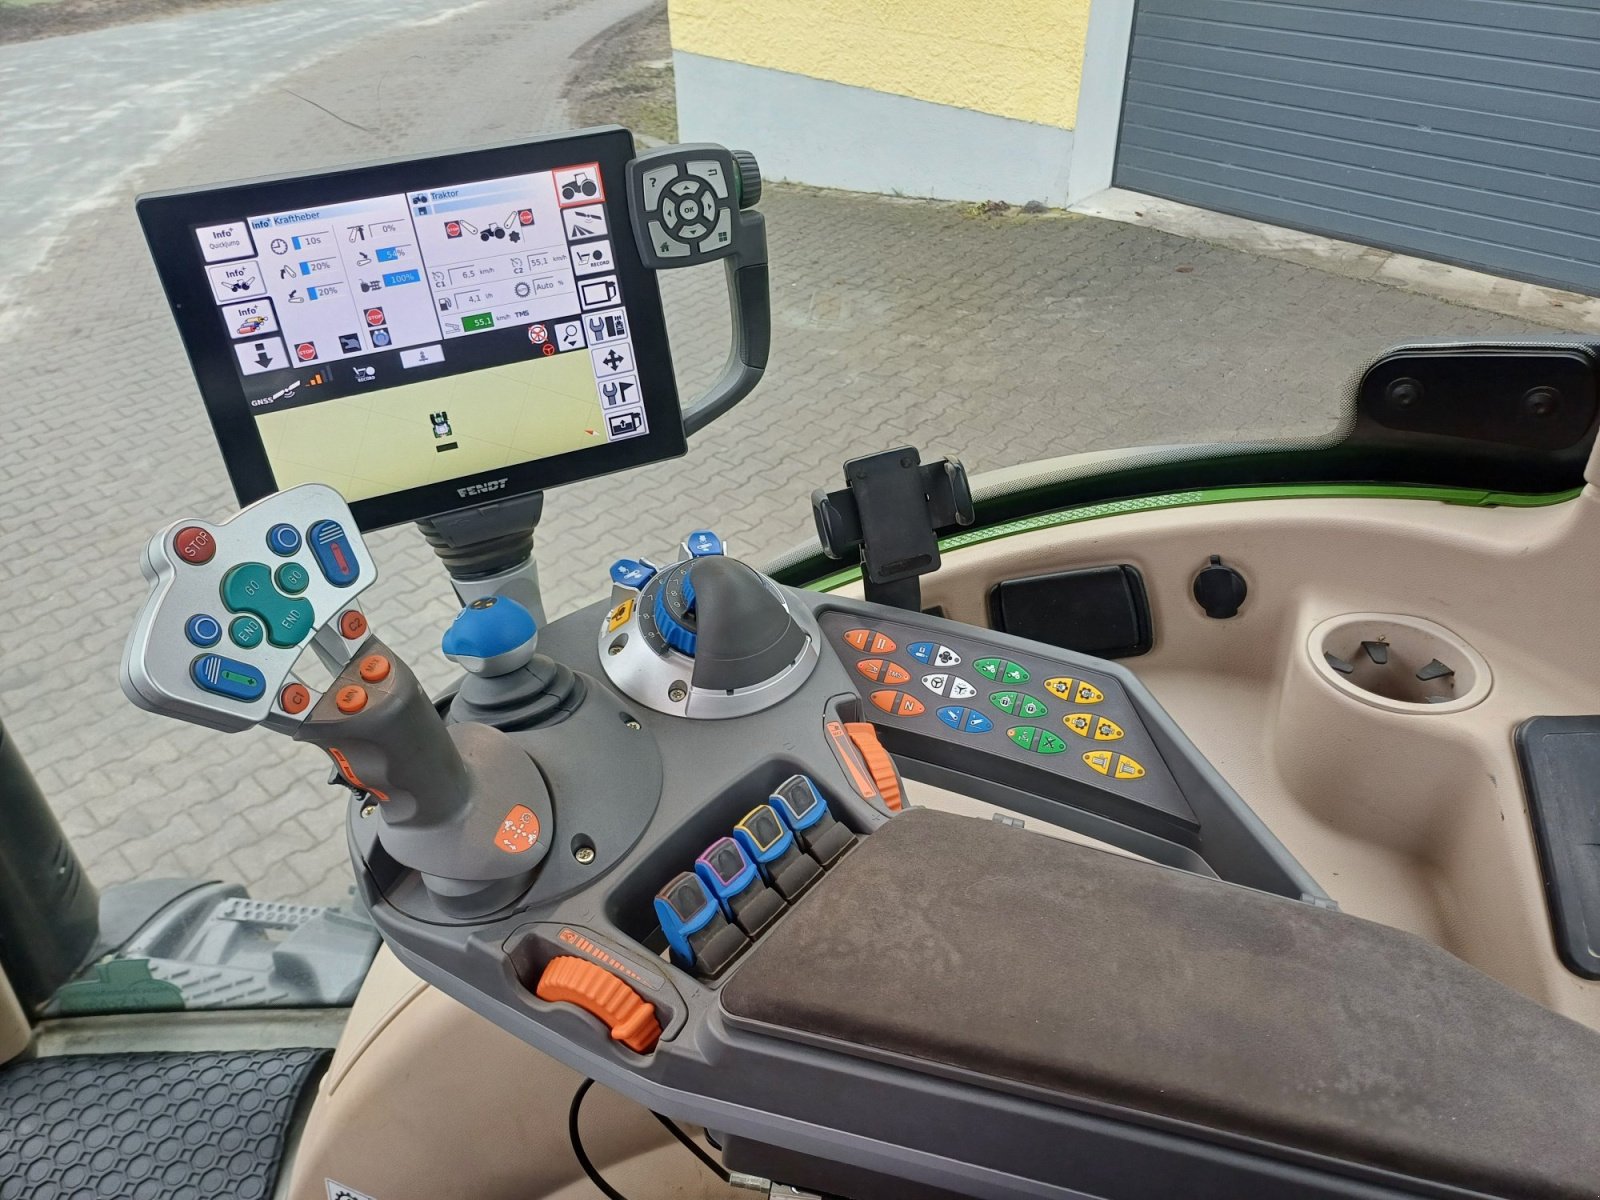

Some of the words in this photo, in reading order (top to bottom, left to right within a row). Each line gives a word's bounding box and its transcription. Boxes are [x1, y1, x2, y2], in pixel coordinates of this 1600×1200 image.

[430, 189, 460, 200] Traktor
[684, 206, 695, 214] OK
[273, 211, 320, 226] Kraftheber
[382, 224, 396, 233] 0%
[305, 236, 322, 246] 10s
[311, 262, 331, 271] 20%
[531, 257, 548, 267] 55,1
[590, 260, 610, 268] RECORD
[462, 270, 476, 279] 6,5
[513, 267, 524, 275] C2
[391, 273, 415, 284] 100%
[318, 286, 338, 296] 20%
[536, 282, 554, 291] Auto
[474, 317, 492, 327] 55,1
[251, 396, 274, 407] GNSS
[456, 477, 509, 498] FENDT
[184, 531, 208, 558] STOP
[288, 569, 303, 585] GO
[244, 579, 260, 597] GO
[281, 608, 301, 631] END
[238, 620, 259, 643] END
[904, 701, 914, 711] N
